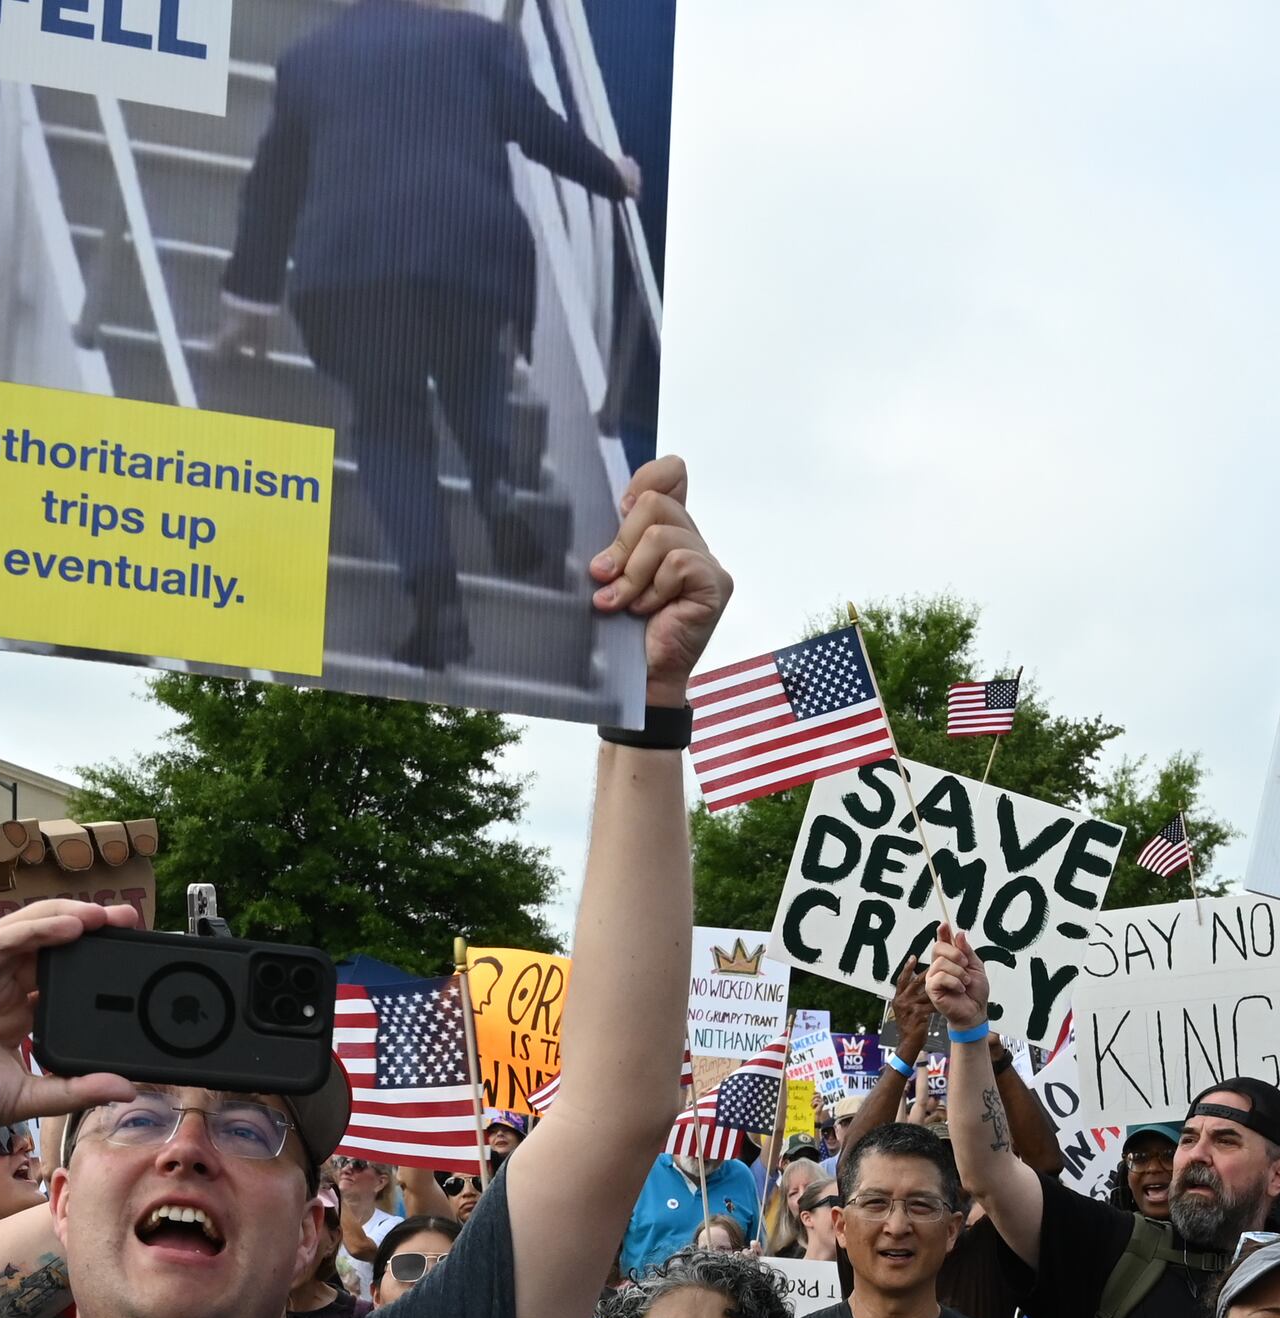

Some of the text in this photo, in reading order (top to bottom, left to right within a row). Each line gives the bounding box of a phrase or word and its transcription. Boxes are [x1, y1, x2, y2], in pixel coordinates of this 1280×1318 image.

[42, 489, 217, 546] trips up
[2, 546, 246, 605] eventually.
[841, 758, 1123, 910] SAVE
[1083, 912, 1181, 978] SAY
[1213, 903, 1275, 964] NO
[691, 978, 784, 1003] NO WICKED KING
[688, 1008, 703, 1021] NO
[706, 1010, 743, 1025] GRUMPY
[744, 1013, 778, 1028] TYRANT
[511, 1031, 531, 1061] IS
[695, 1028, 713, 1048] NO
[788, 1048, 814, 1067] ASN'T
[844, 1055, 863, 1065] NO
[786, 1063, 813, 1080] ROKEN
[821, 1078, 843, 1093] LOVE
[823, 1089, 846, 1105] OUGH
